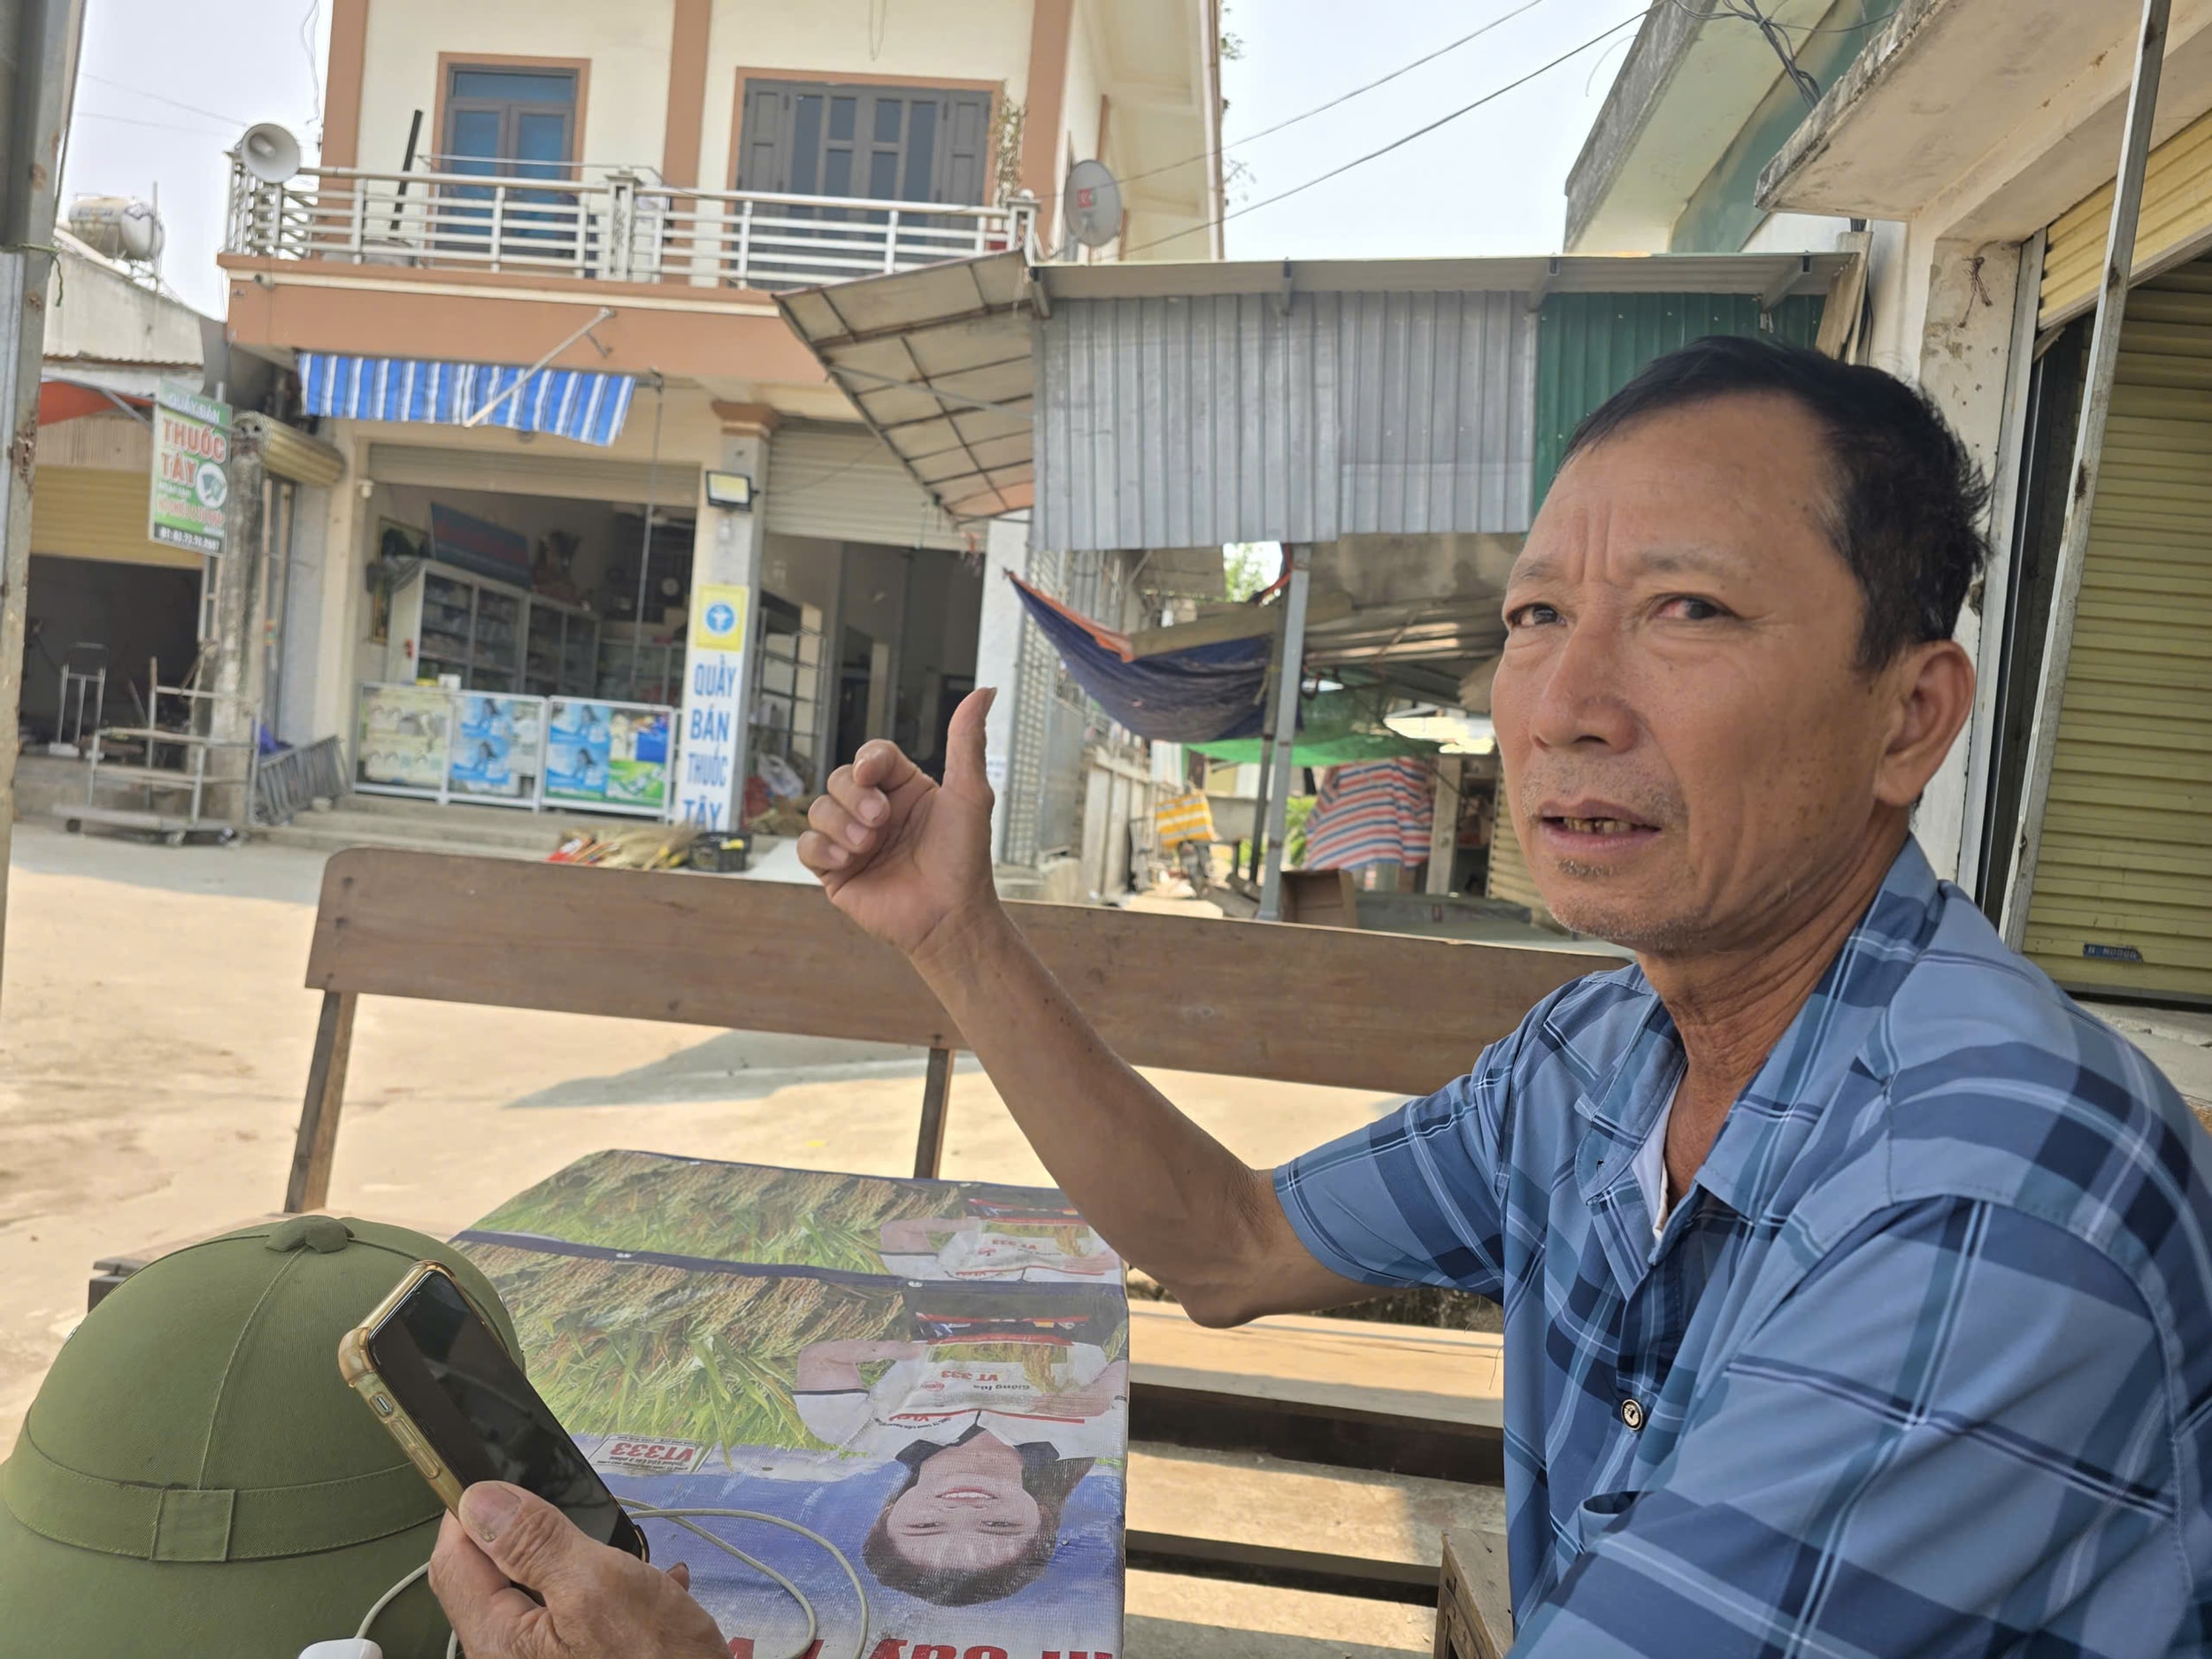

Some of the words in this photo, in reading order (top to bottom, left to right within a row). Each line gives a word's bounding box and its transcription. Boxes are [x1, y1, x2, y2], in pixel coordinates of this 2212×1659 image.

[163, 417, 226, 461] THUỐC
[690, 703, 731, 741] BÁN
[683, 795, 723, 832] TÂY
[941, 1371, 973, 1380] 333
[610, 1442, 695, 1462] VT333
